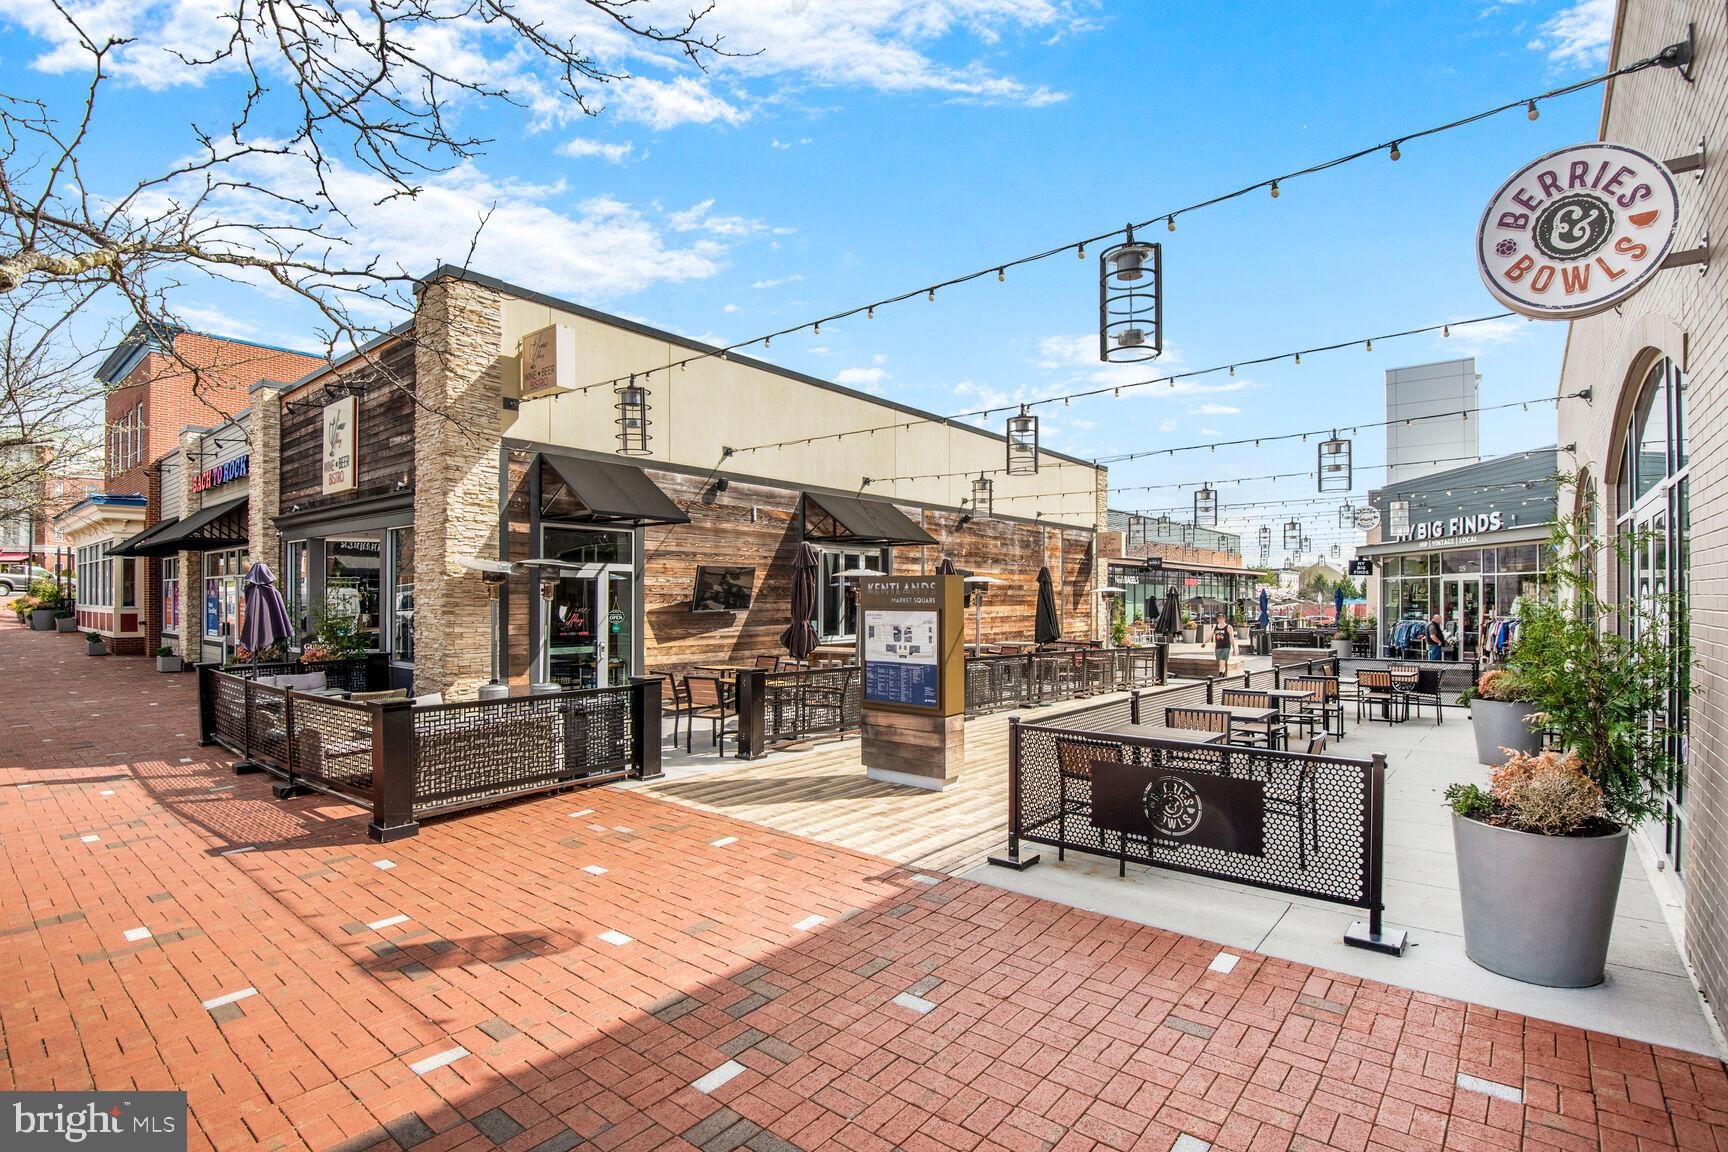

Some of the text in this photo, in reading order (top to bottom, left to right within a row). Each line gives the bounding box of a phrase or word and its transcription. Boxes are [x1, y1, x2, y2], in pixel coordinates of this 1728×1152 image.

[1496, 160, 1652, 230] BERRIES
[1550, 205, 1599, 250] &
[1503, 236, 1648, 295] BOWLS
[192, 455, 247, 493] BACH TO ROCK
[338, 455, 350, 469] BEER
[1417, 520, 1443, 540] BIG
[1449, 511, 1501, 536] FINDS
[1460, 536, 1477, 544] LOCAL
[867, 582, 936, 594] KENTLANDS
